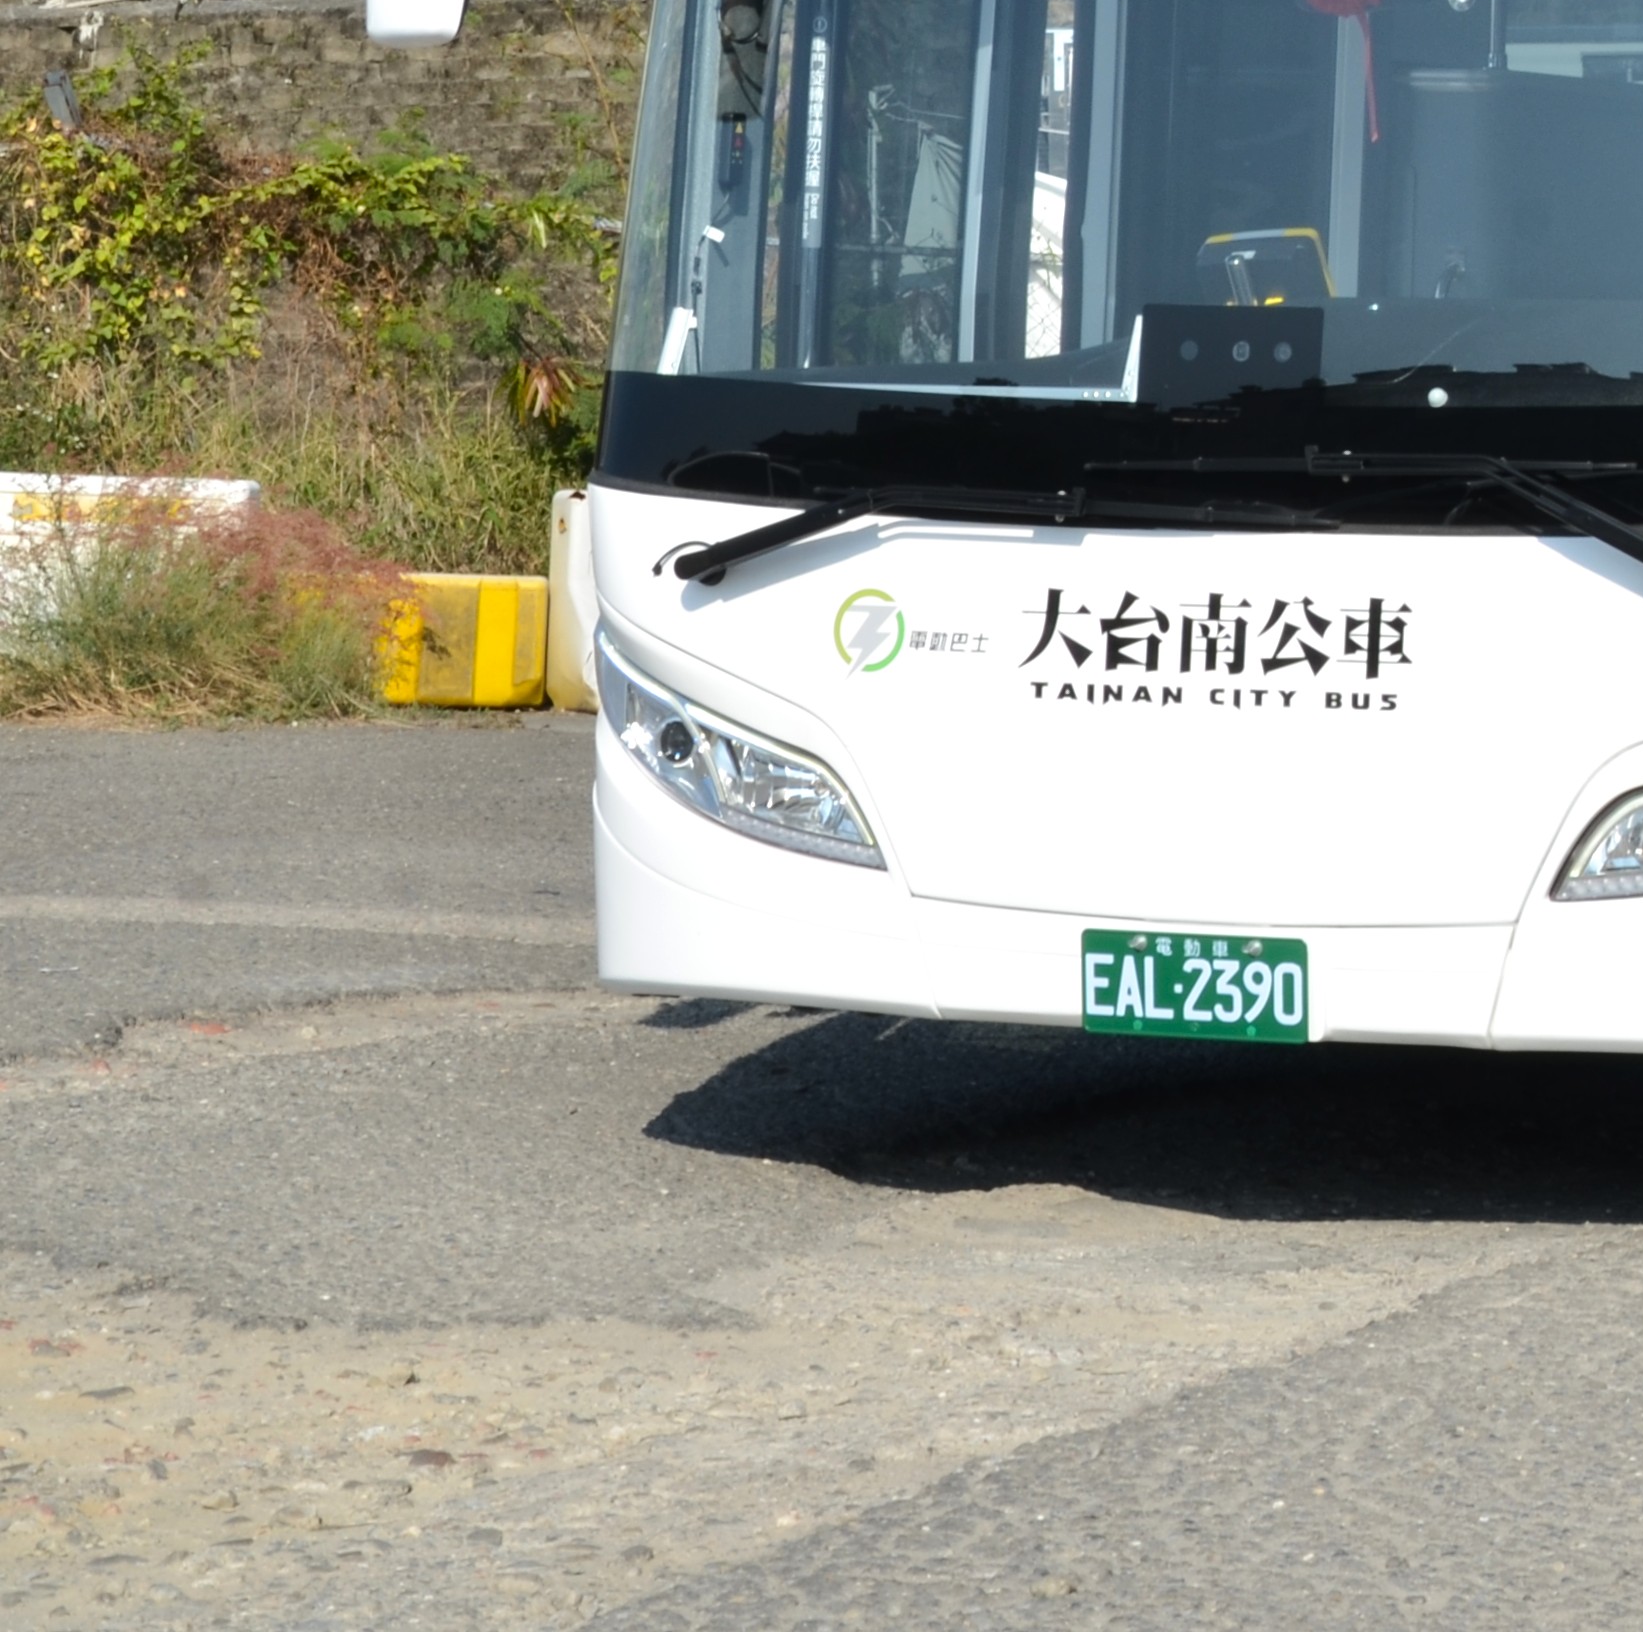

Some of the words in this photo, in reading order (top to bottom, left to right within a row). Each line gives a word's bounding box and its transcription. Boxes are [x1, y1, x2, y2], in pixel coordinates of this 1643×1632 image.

[909, 631, 989, 653] 電動巴士
[1018, 587, 1413, 680] 大台南公車
[1031, 681, 1182, 706] TAINAN
[1209, 687, 1296, 710] CITY
[1325, 691, 1398, 711] BUS
[1155, 937, 1229, 958] 電動車
